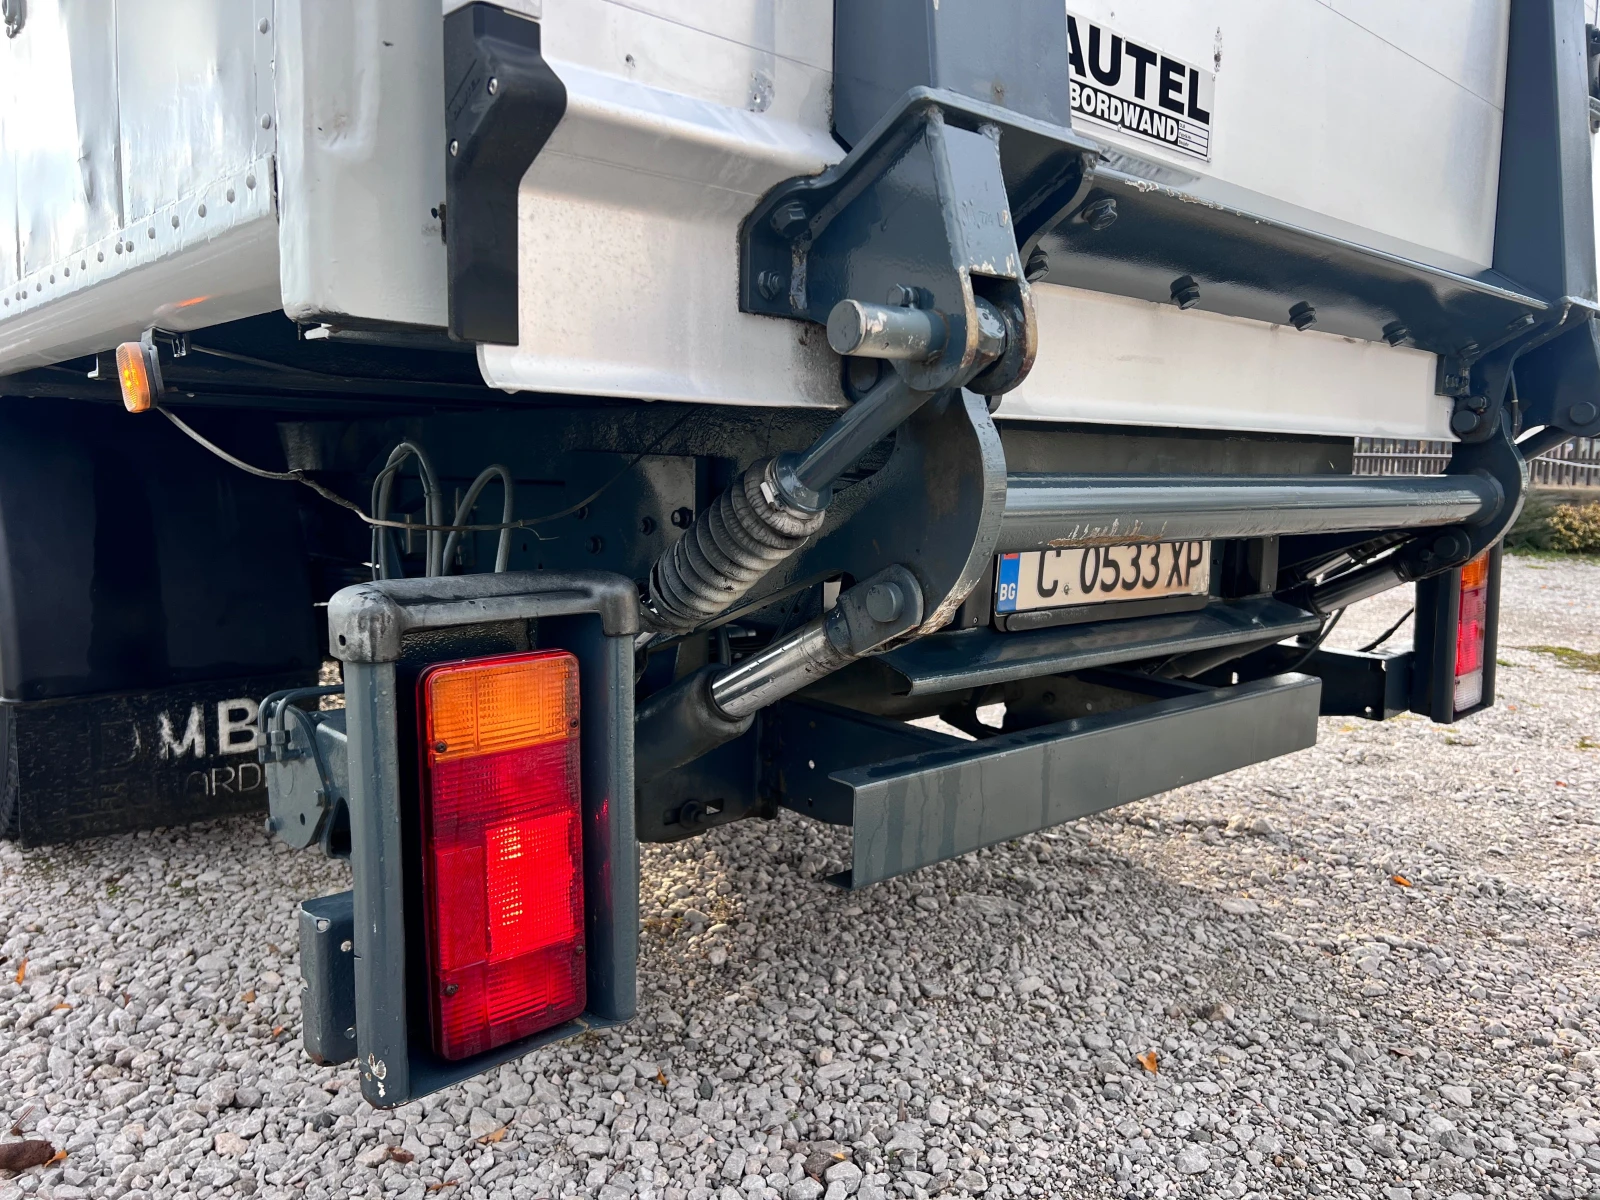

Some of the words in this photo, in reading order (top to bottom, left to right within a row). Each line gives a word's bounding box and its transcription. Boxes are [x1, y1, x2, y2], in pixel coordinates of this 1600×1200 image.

[1070, 81, 1179, 142] BORDWAND
[1000, 583, 1017, 602] BG
[1036, 550, 1062, 598] C
[1080, 543, 1161, 595] 0533
